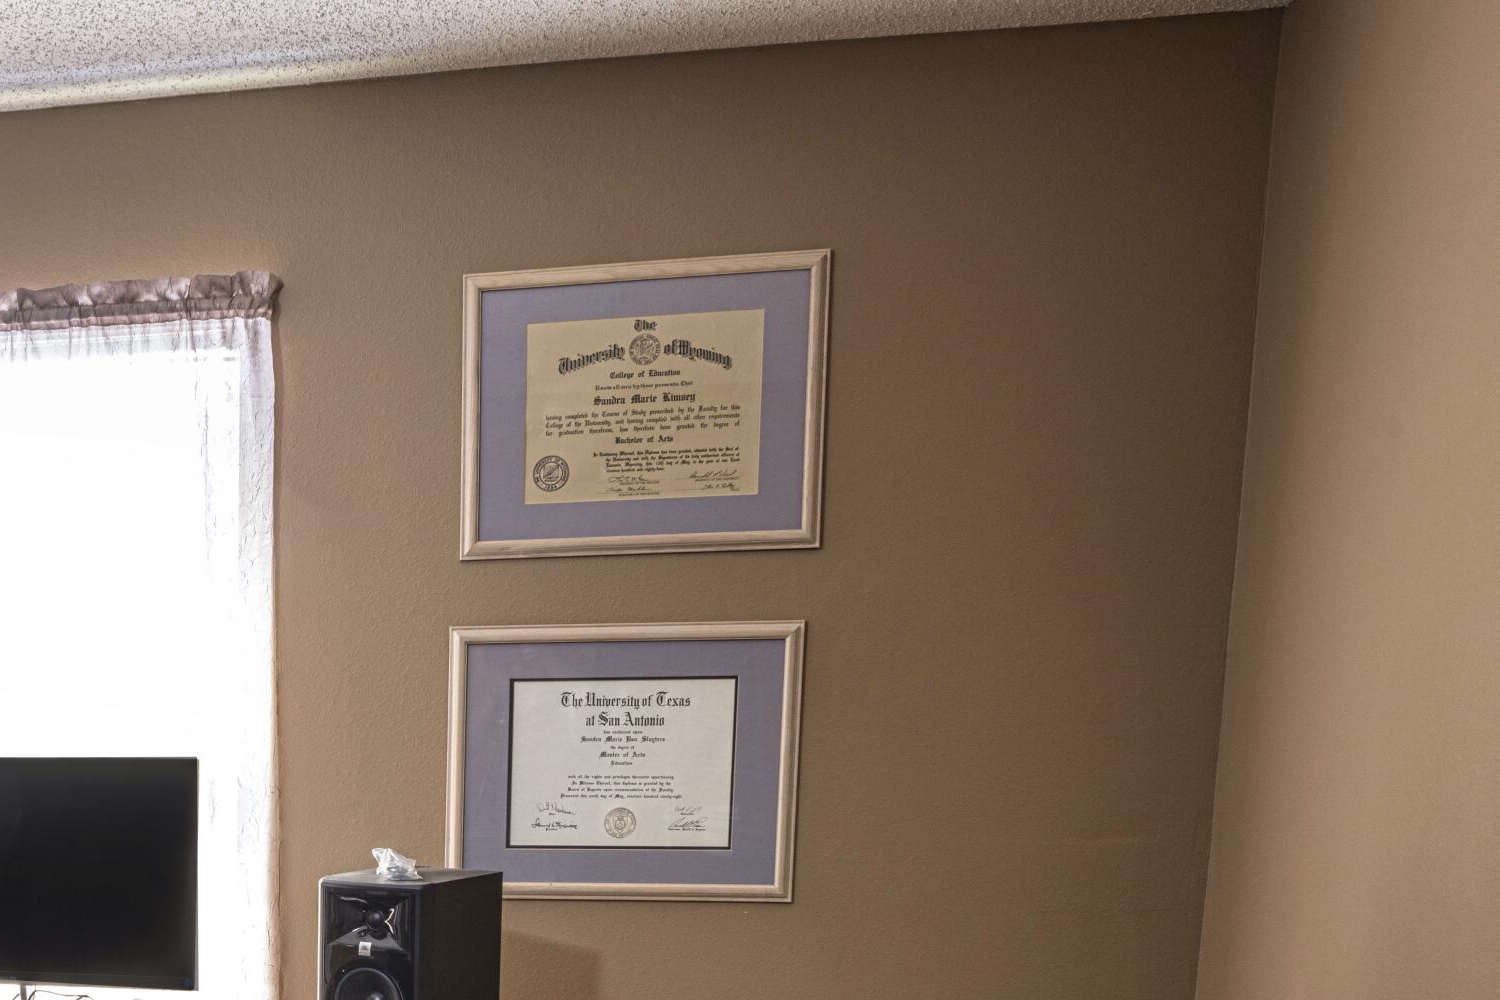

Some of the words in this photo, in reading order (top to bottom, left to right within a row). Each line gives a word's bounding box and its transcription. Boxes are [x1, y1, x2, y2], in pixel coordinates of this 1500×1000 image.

[634, 320, 658, 332] The
[558, 344, 626, 376] University
[677, 339, 732, 370] Wyoming
[594, 396, 626, 406] Sandra
[630, 394, 657, 404] Marie
[560, 692, 583, 708] The
[584, 692, 640, 709] University
[641, 694, 654, 707] of
[656, 691, 691, 707] Texas
[585, 715, 595, 726] at
[598, 711, 620, 727] San
[623, 711, 665, 727] Antonio
